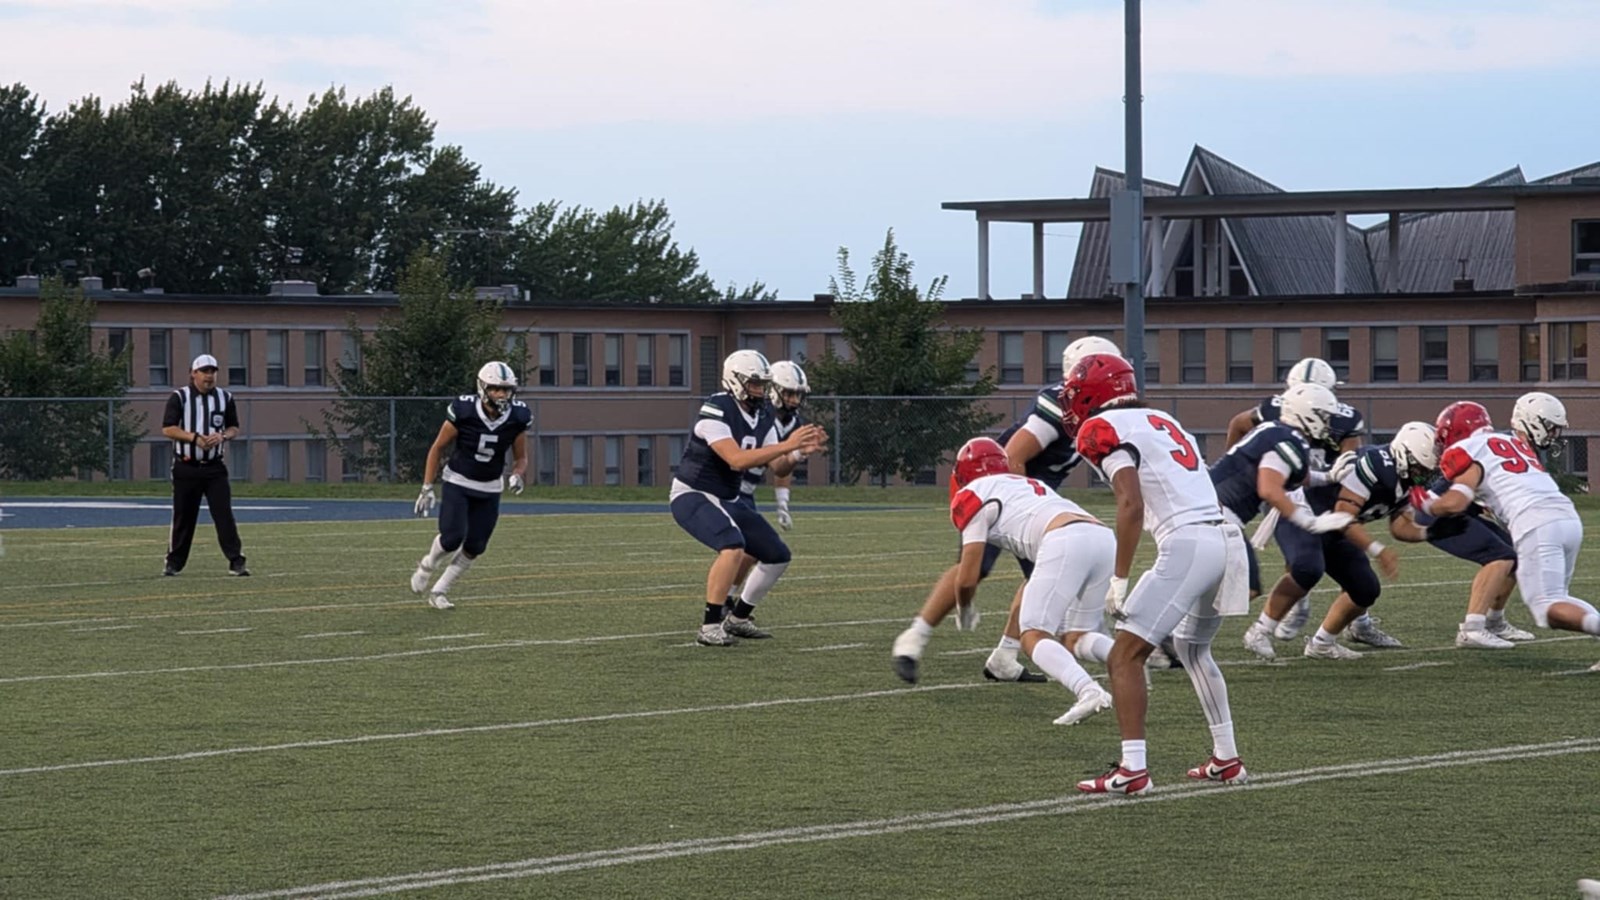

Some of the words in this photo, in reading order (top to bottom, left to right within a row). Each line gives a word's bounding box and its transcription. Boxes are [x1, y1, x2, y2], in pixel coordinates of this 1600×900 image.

[474, 433, 499, 463] 5
[1146, 414, 1199, 471] 3
[1487, 436, 1547, 474] 99
